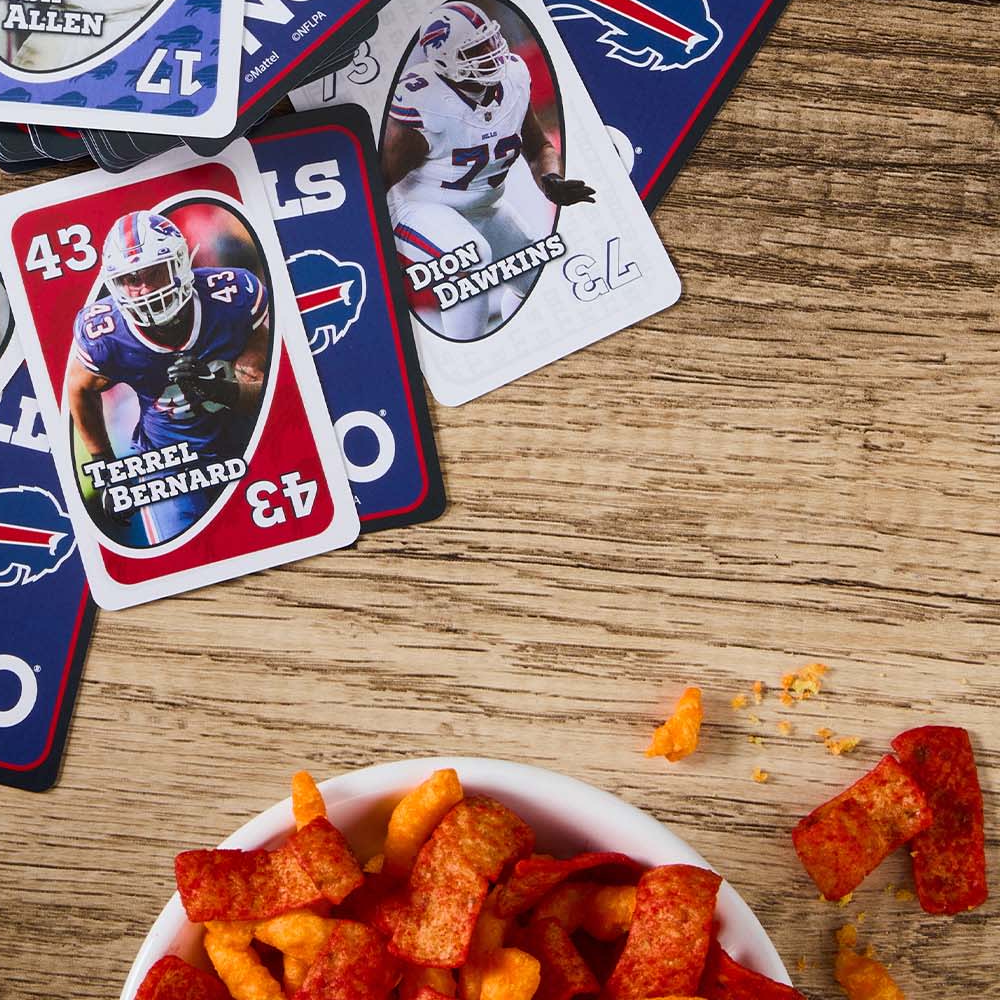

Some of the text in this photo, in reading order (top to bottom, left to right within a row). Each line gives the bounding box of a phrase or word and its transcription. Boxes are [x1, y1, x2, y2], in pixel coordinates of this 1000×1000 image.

[3, 3, 104, 38] ALLEN
[244, 9, 327, 84] ©Mattel ©NFLPA
[136, 47, 206, 96] 17
[440, 133, 522, 191] 73
[24, 223, 99, 281] 43
[406, 241, 482, 295] DION
[431, 232, 568, 312] DAWKINS
[562, 236, 641, 303] 73
[207, 270, 238, 303] 43
[84, 441, 199, 490] TERREL
[109, 456, 249, 515] BERNARD
[245, 470, 319, 530] 43
